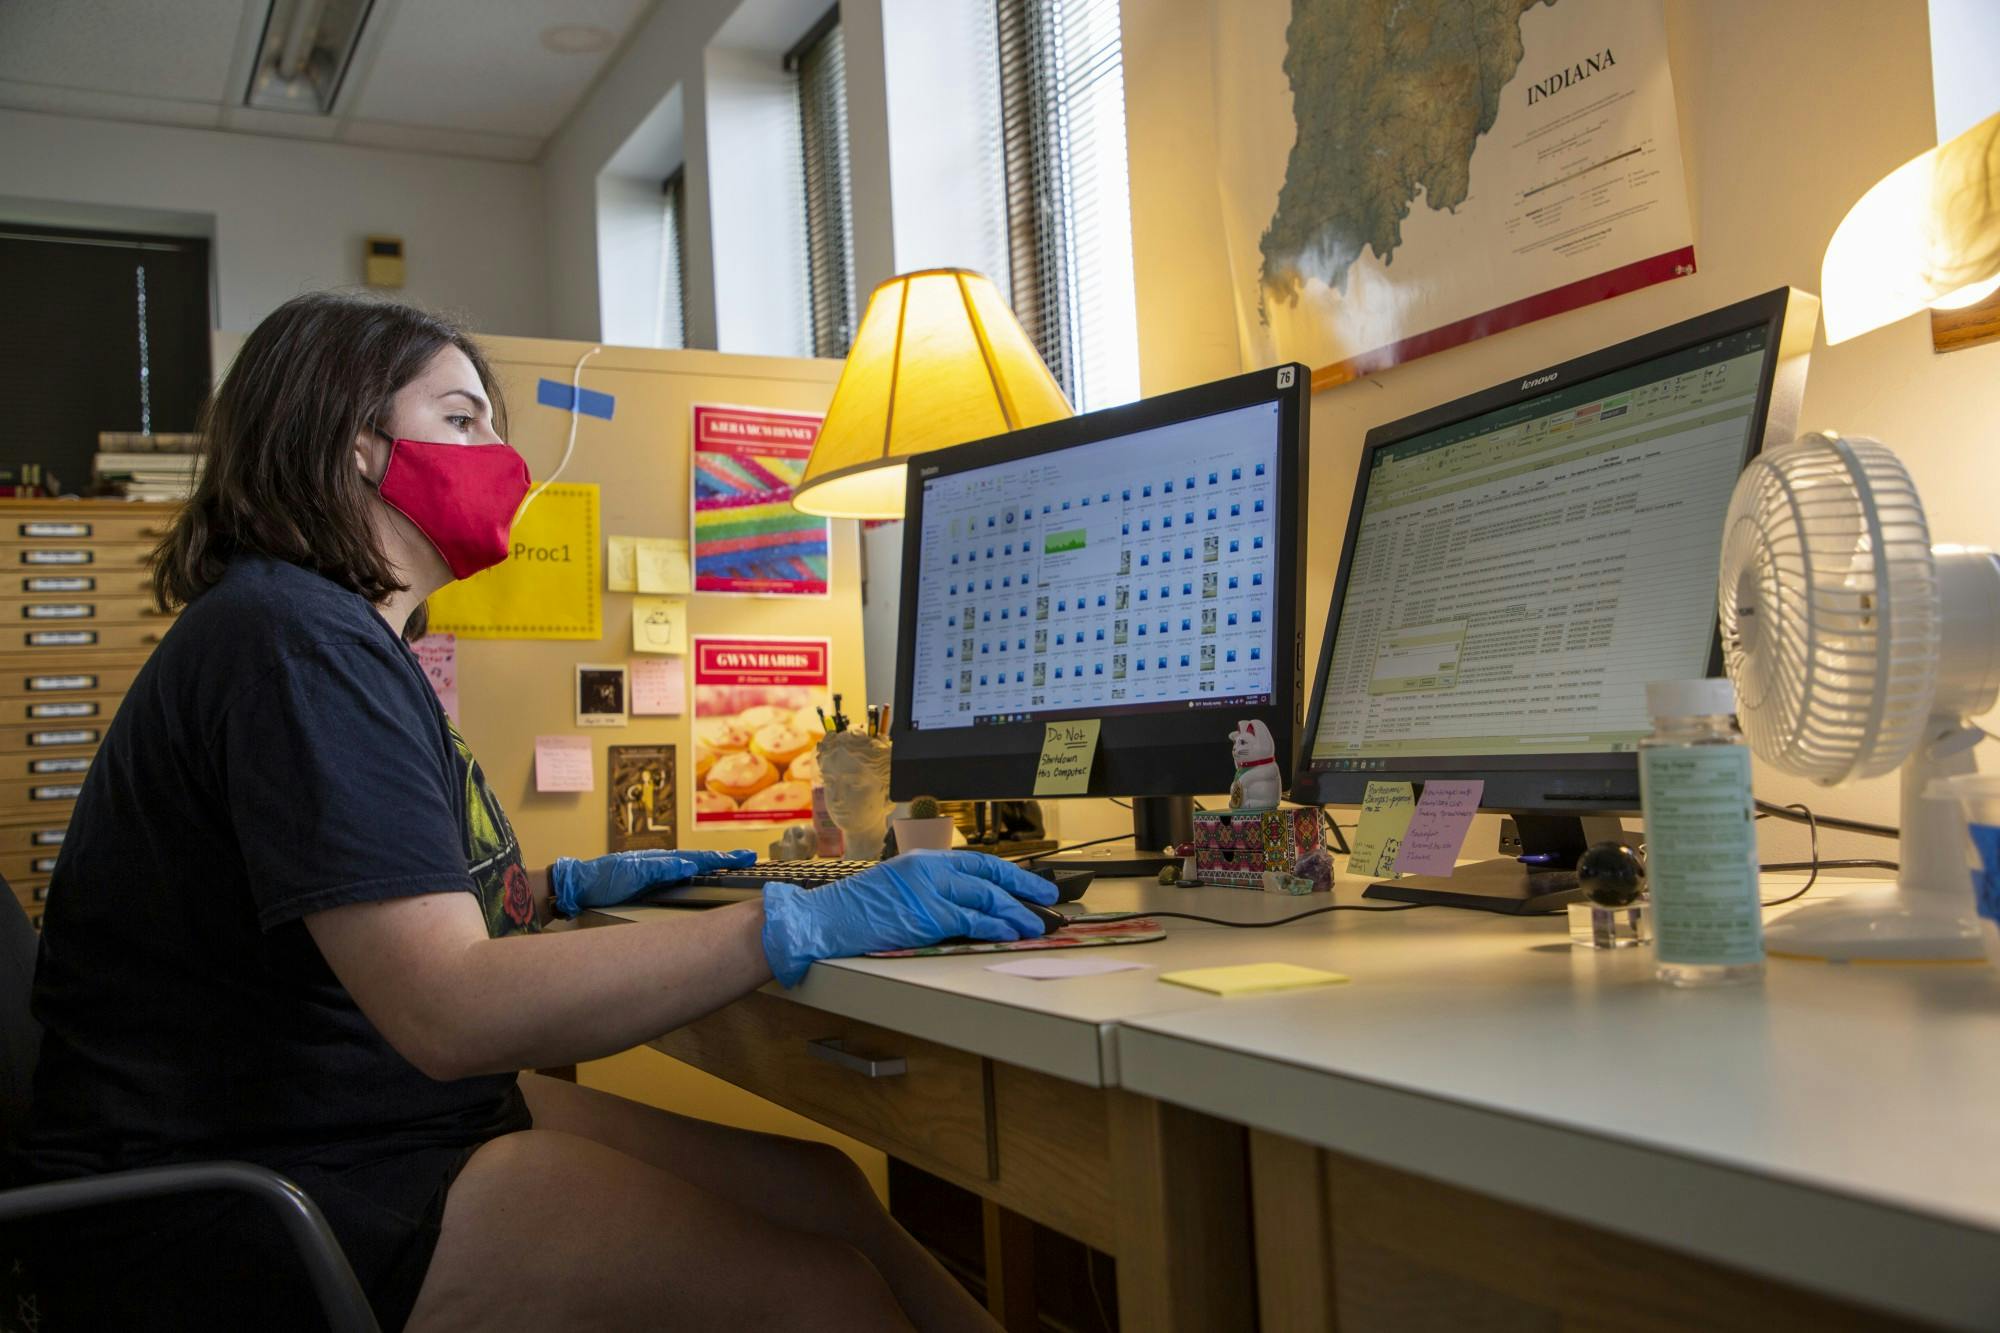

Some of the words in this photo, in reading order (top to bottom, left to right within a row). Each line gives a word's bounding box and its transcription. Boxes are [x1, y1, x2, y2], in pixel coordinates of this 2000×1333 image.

[1527, 48, 1616, 107] INDIANA
[1280, 371, 1291, 385] 76
[1521, 372, 1558, 391] lenovo
[758, 653, 809, 668] HARRIS
[1048, 727, 1062, 743] Do
[1065, 726, 1087, 742] Not
